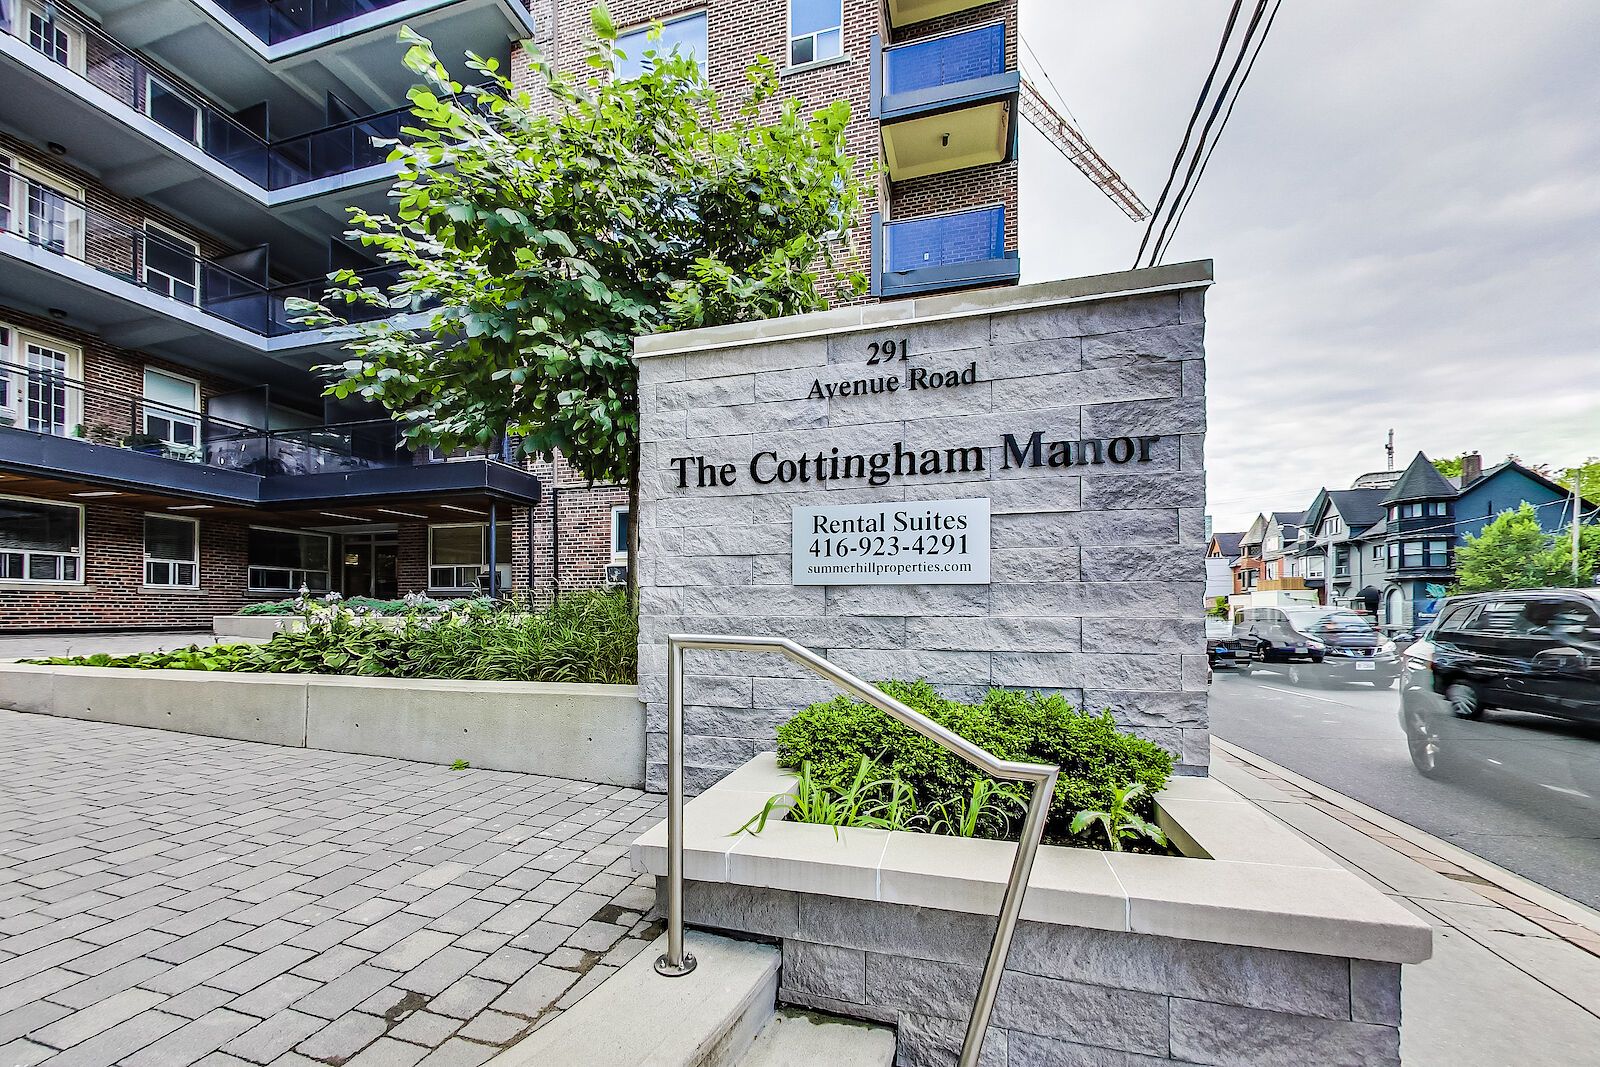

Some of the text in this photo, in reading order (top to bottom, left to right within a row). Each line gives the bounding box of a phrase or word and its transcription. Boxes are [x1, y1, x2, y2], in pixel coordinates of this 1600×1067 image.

[866, 338, 910, 366] 291
[807, 362, 977, 400] Avenue Road
[670, 431, 1160, 489] The Cottingham Manor
[812, 510, 968, 534] Rental Suites
[809, 534, 970, 558] 416-923-4291
[807, 561, 972, 576] summerhillproperties.com
